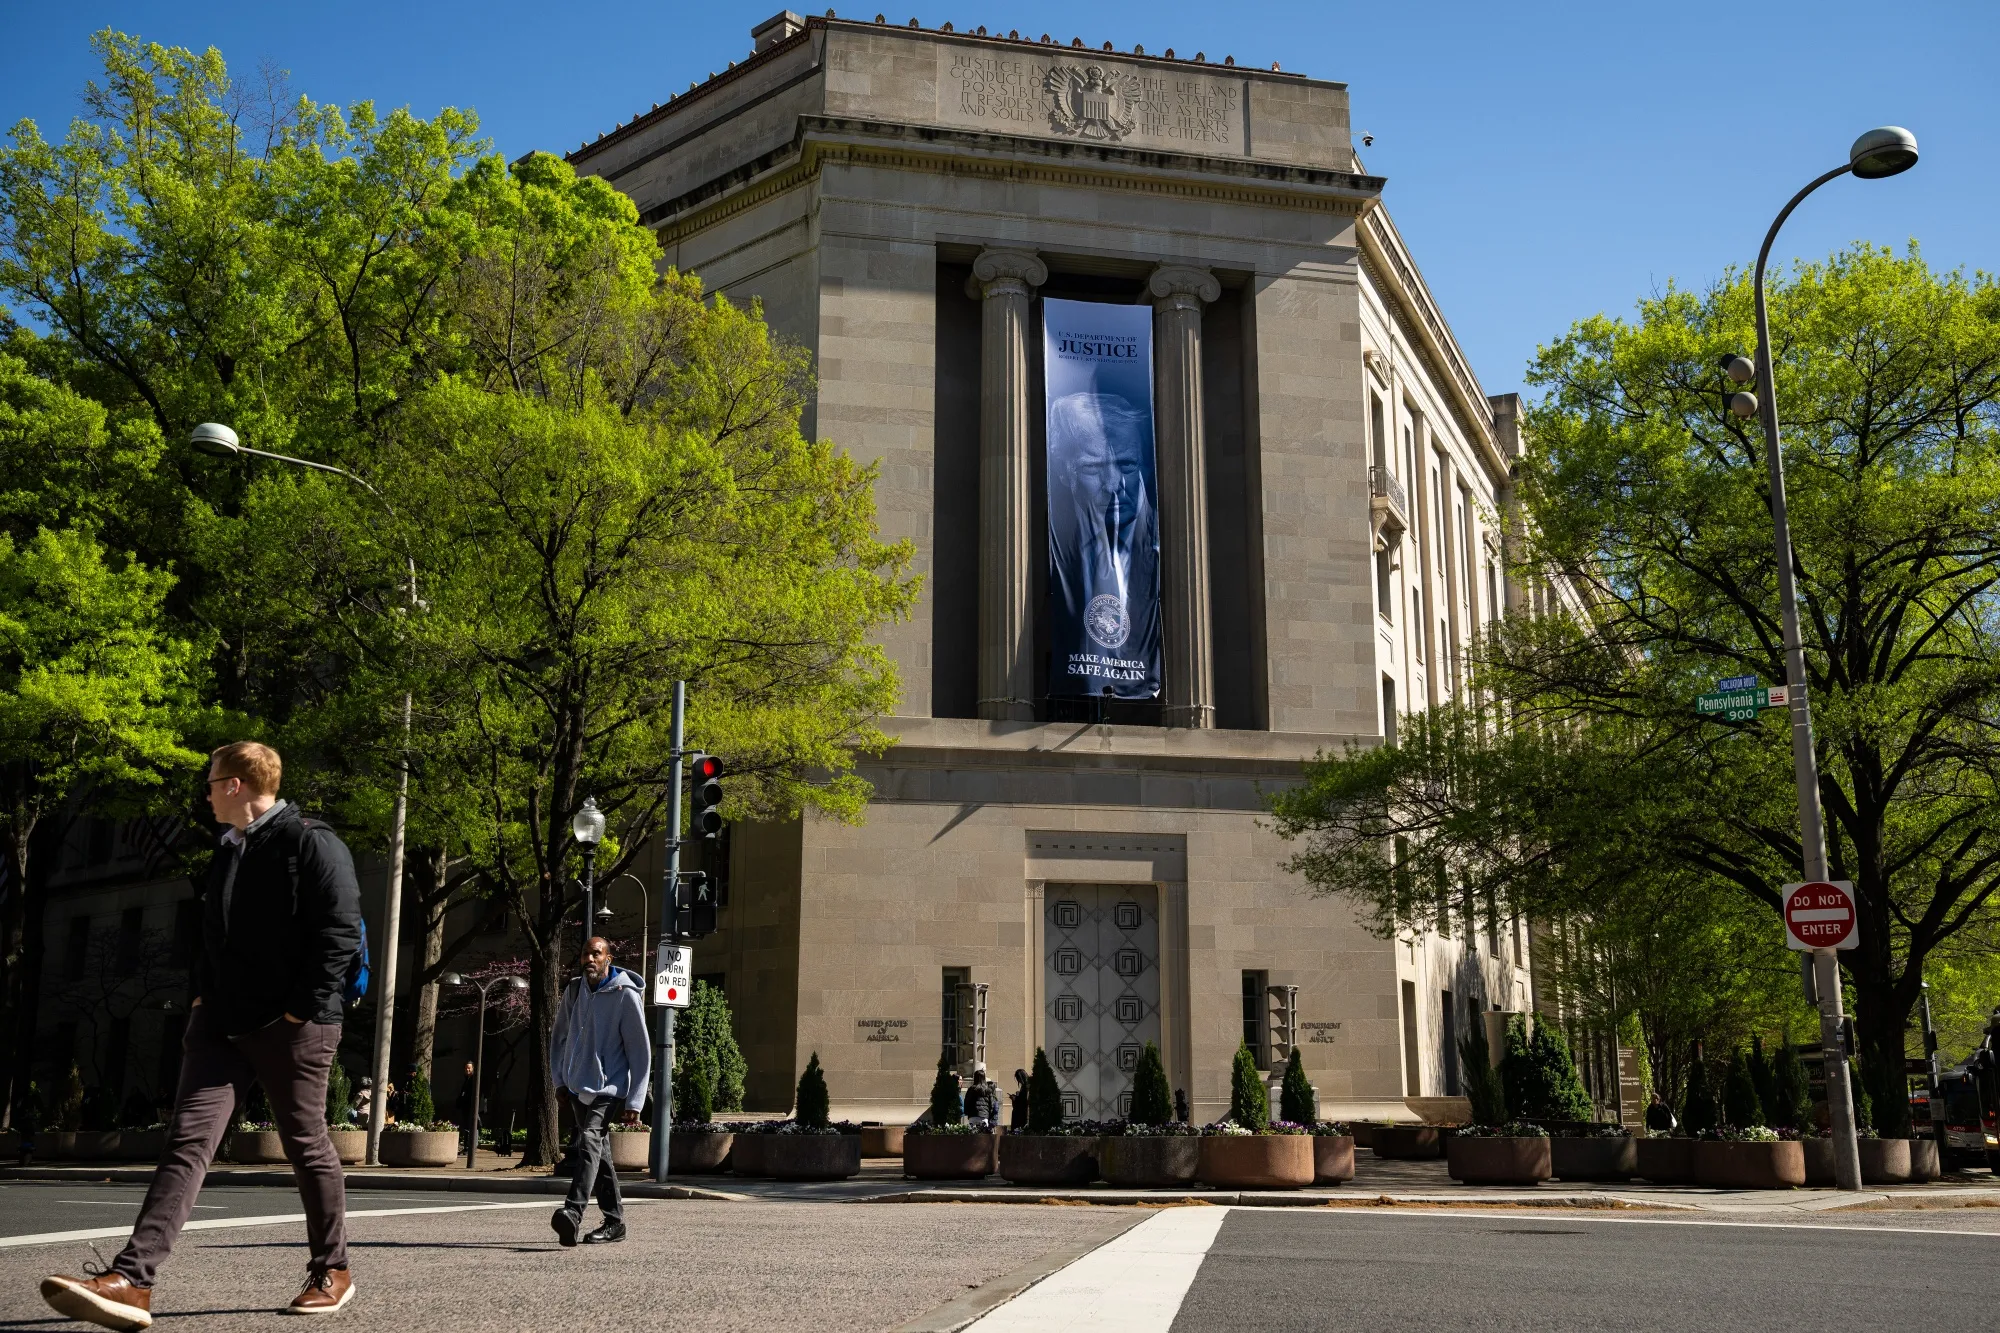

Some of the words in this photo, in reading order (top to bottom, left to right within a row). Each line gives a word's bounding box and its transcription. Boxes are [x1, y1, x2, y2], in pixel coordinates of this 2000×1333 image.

[951, 55, 1021, 75] JUSTICE
[1031, 64, 1048, 77] IN
[1143, 77, 1167, 91] THE
[1176, 81, 1201, 95] LIFE
[1208, 85, 1237, 99] AND
[950, 66, 1024, 86] CONDUCT
[1146, 89, 1169, 103] THE
[1177, 93, 1214, 108] STATE
[1224, 98, 1236, 111] IS
[962, 79, 1049, 101] POSSIBLE
[1138, 100, 1172, 115] ONLY
[1176, 105, 1192, 117] AS
[1196, 106, 1228, 120] FIRST
[961, 91, 971, 104] IT
[977, 93, 1033, 111] RESIDES
[1038, 100, 1051, 113] IN
[1145, 112, 1170, 126] THE
[1178, 115, 1229, 132] HEARTS
[958, 103, 986, 117] AND
[991, 106, 1034, 122] SOULS
[1039, 112, 1051, 124] OF
[1141, 123, 1163, 137] THE
[1168, 126, 1230, 144] CITIZENS.
[1074, 332, 1125, 343] DEPARTMENT
[1058, 339, 1138, 358] JUSTICE
[1068, 653, 1099, 663] MAKE
[1100, 656, 1145, 669] AMERICA
[1067, 664, 1101, 676] SAFE
[1102, 667, 1146, 680] AGAIN
[1698, 692, 1754, 711] Pennsylvania
[1757, 697, 1765, 705] NW
[1729, 709, 1754, 720] 900
[1794, 896, 1810, 907] DO
[1818, 894, 1843, 906] NOT
[1801, 923, 1841, 936] ENTER
[667, 950, 682, 962] NO
[665, 963, 684, 974] TURN
[659, 975, 669, 985] ON
[672, 976, 687, 987] RED
[858, 1019, 884, 1028] UNITED
[885, 1019, 909, 1028] STATES
[1300, 1022, 1342, 1030] DEPARTMENT
[866, 1034, 899, 1042] AMERICA
